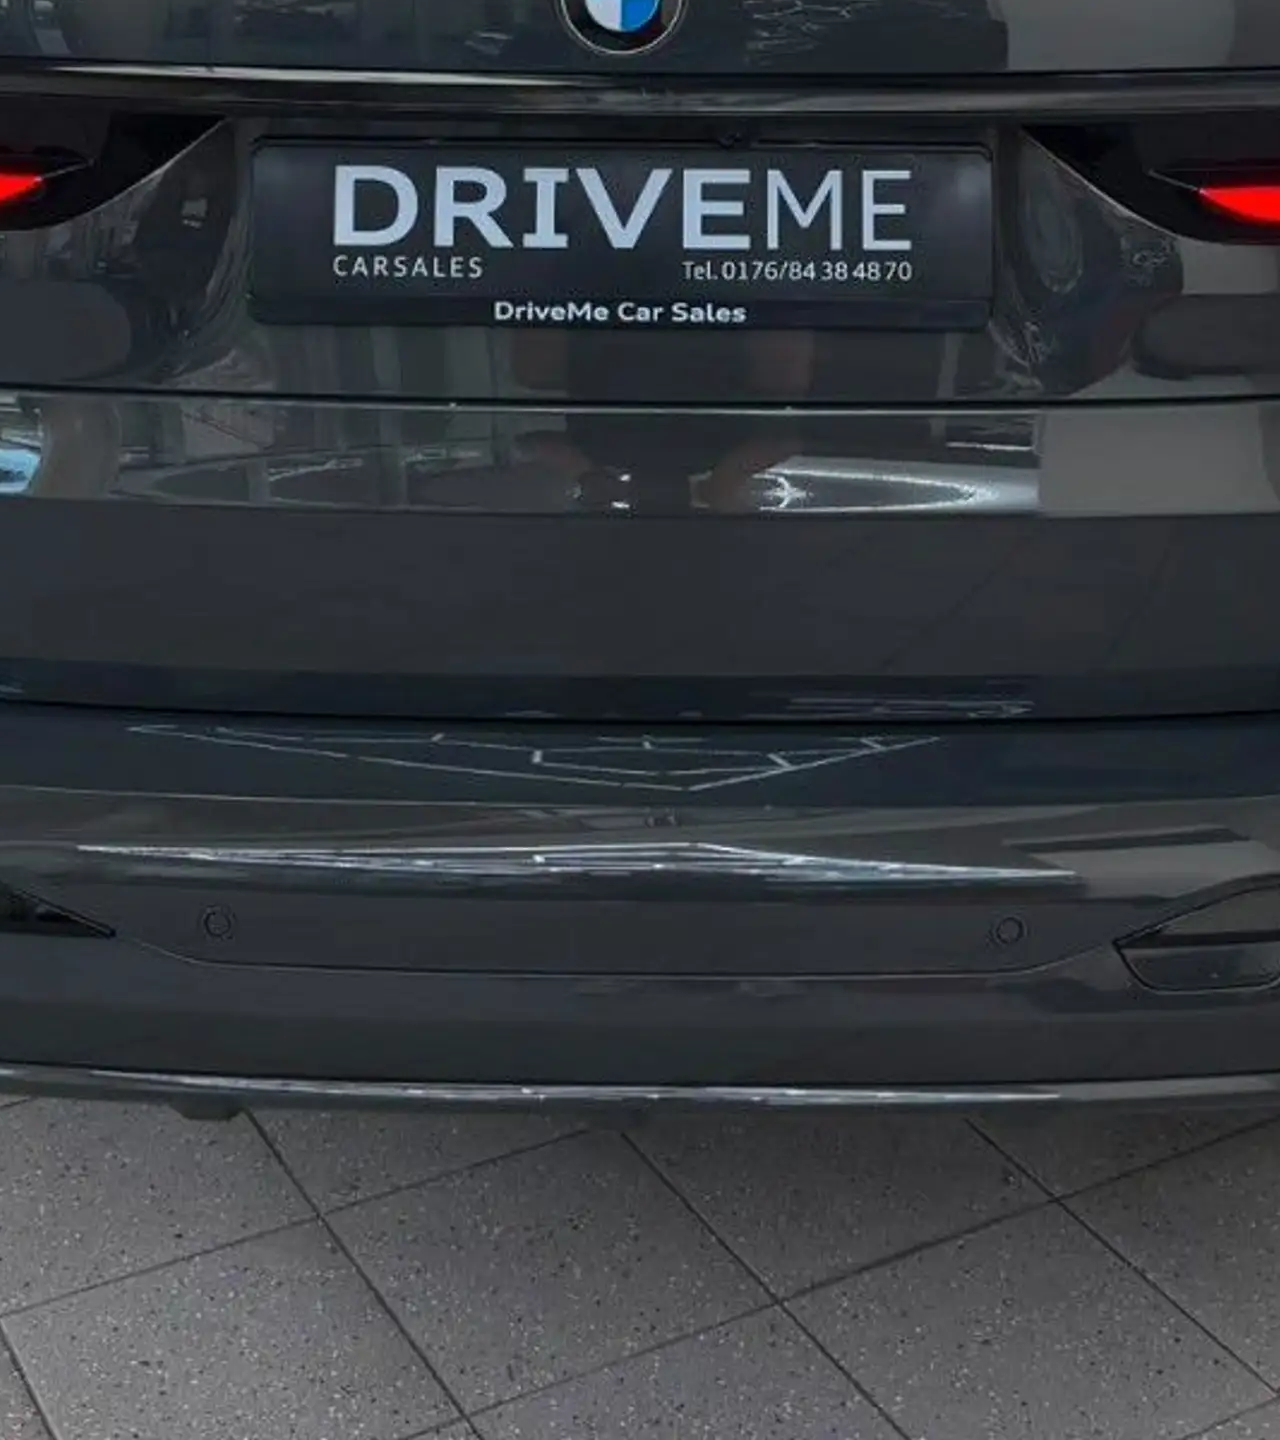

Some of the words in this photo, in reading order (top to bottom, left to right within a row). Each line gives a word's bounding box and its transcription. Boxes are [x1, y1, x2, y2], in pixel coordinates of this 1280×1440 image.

[333, 164, 912, 251] DRIVEME
[332, 254, 484, 280] CARSALES
[681, 260, 718, 281] Tel.
[721, 260, 816, 282] 0176/84
[821, 261, 849, 282] 38
[852, 261, 882, 282] 48
[885, 261, 913, 282] 70
[494, 301, 609, 322] DriveMe
[617, 301, 664, 323] Car
[671, 301, 747, 324] Sales
